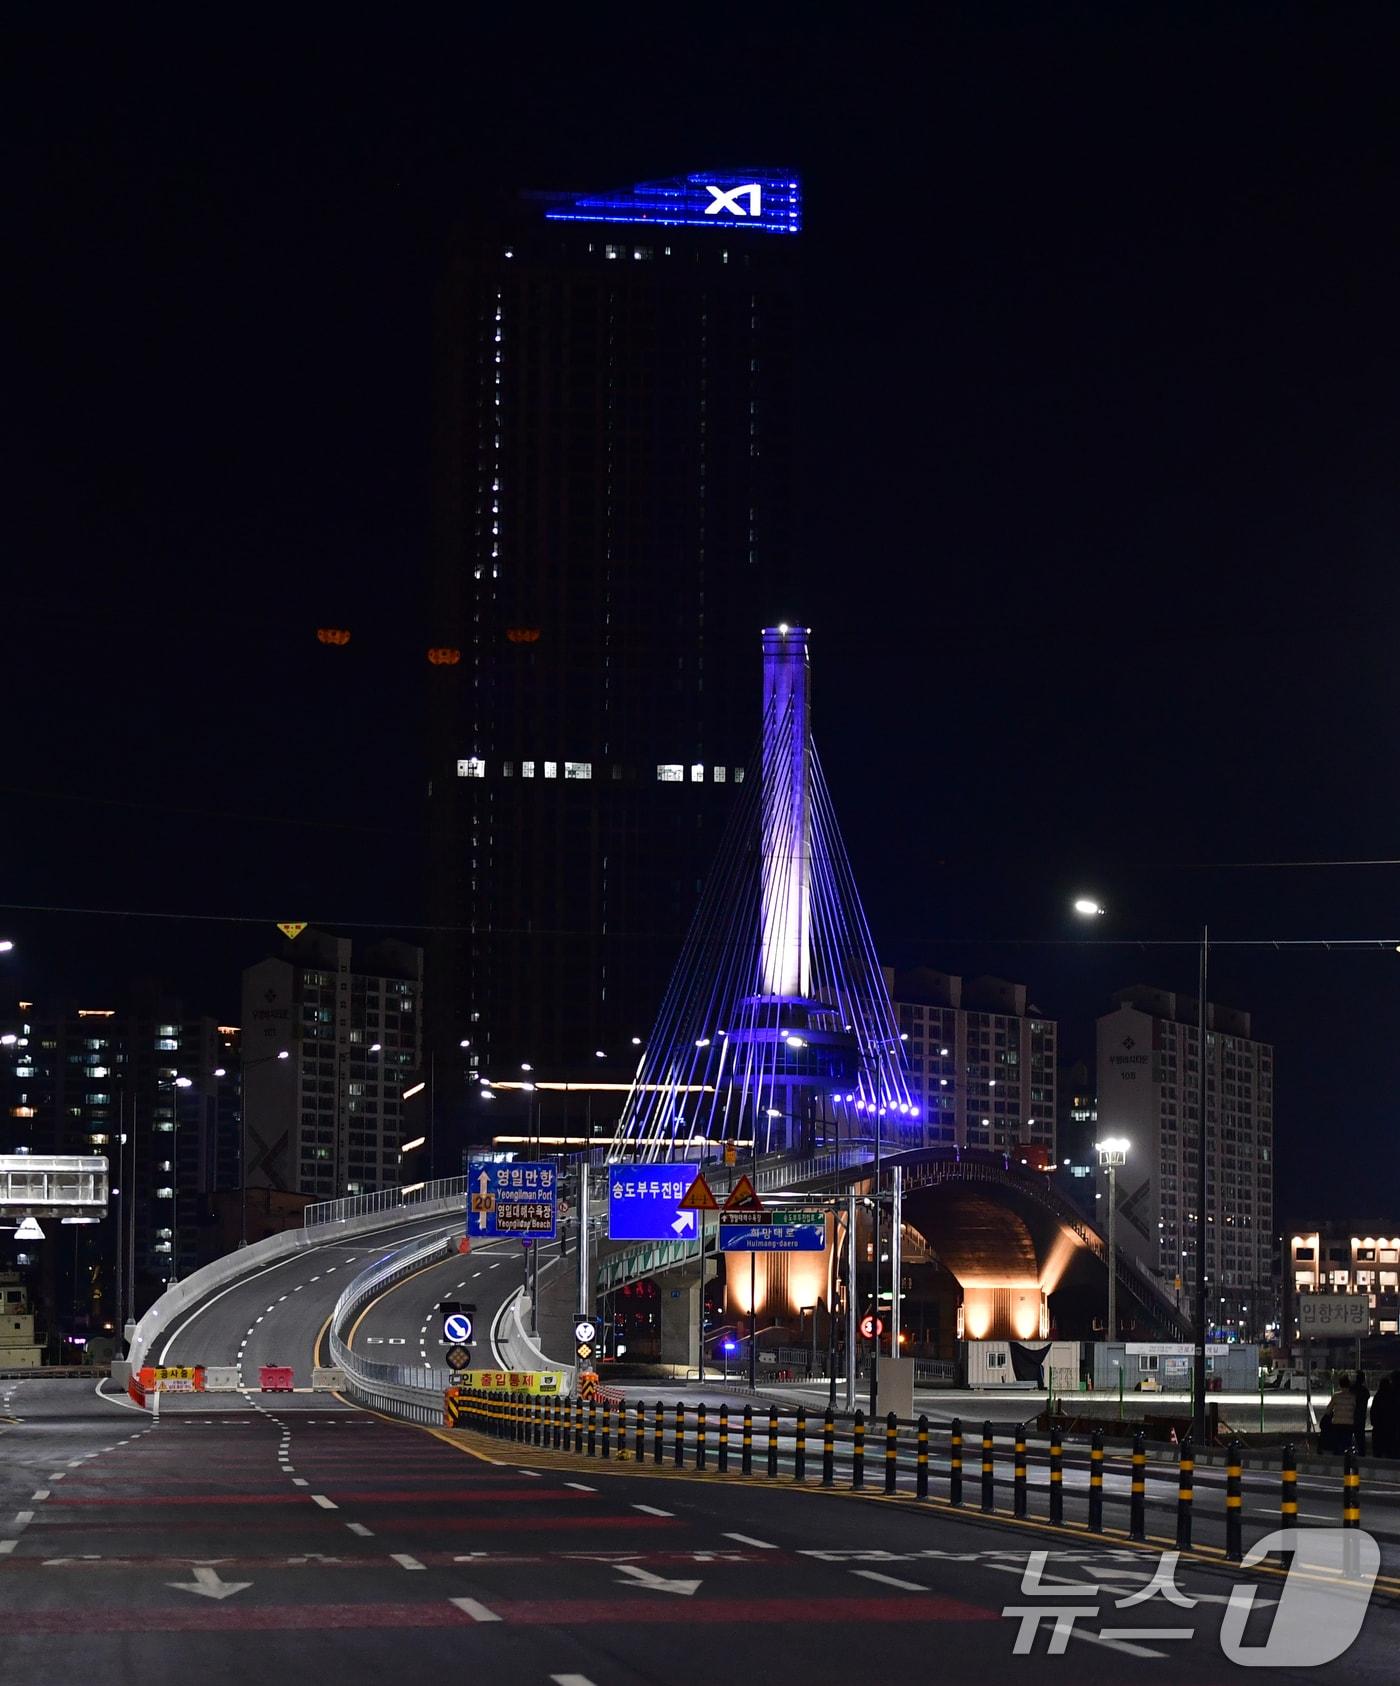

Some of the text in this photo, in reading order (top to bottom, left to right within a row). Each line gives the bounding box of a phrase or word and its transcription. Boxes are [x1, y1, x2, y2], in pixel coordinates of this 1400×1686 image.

[497, 1169, 553, 1187] 영일만항
[497, 1189, 553, 1202] Yeongilman Port
[475, 1197, 492, 1210] 20
[497, 1205, 551, 1218] 영일대해수욕장
[532, 1219, 551, 1229] Beach
[751, 1227, 795, 1240] 희망대로
[1303, 1304, 1364, 1324] 입항차량
[481, 1373, 533, 1387] 출입통제
